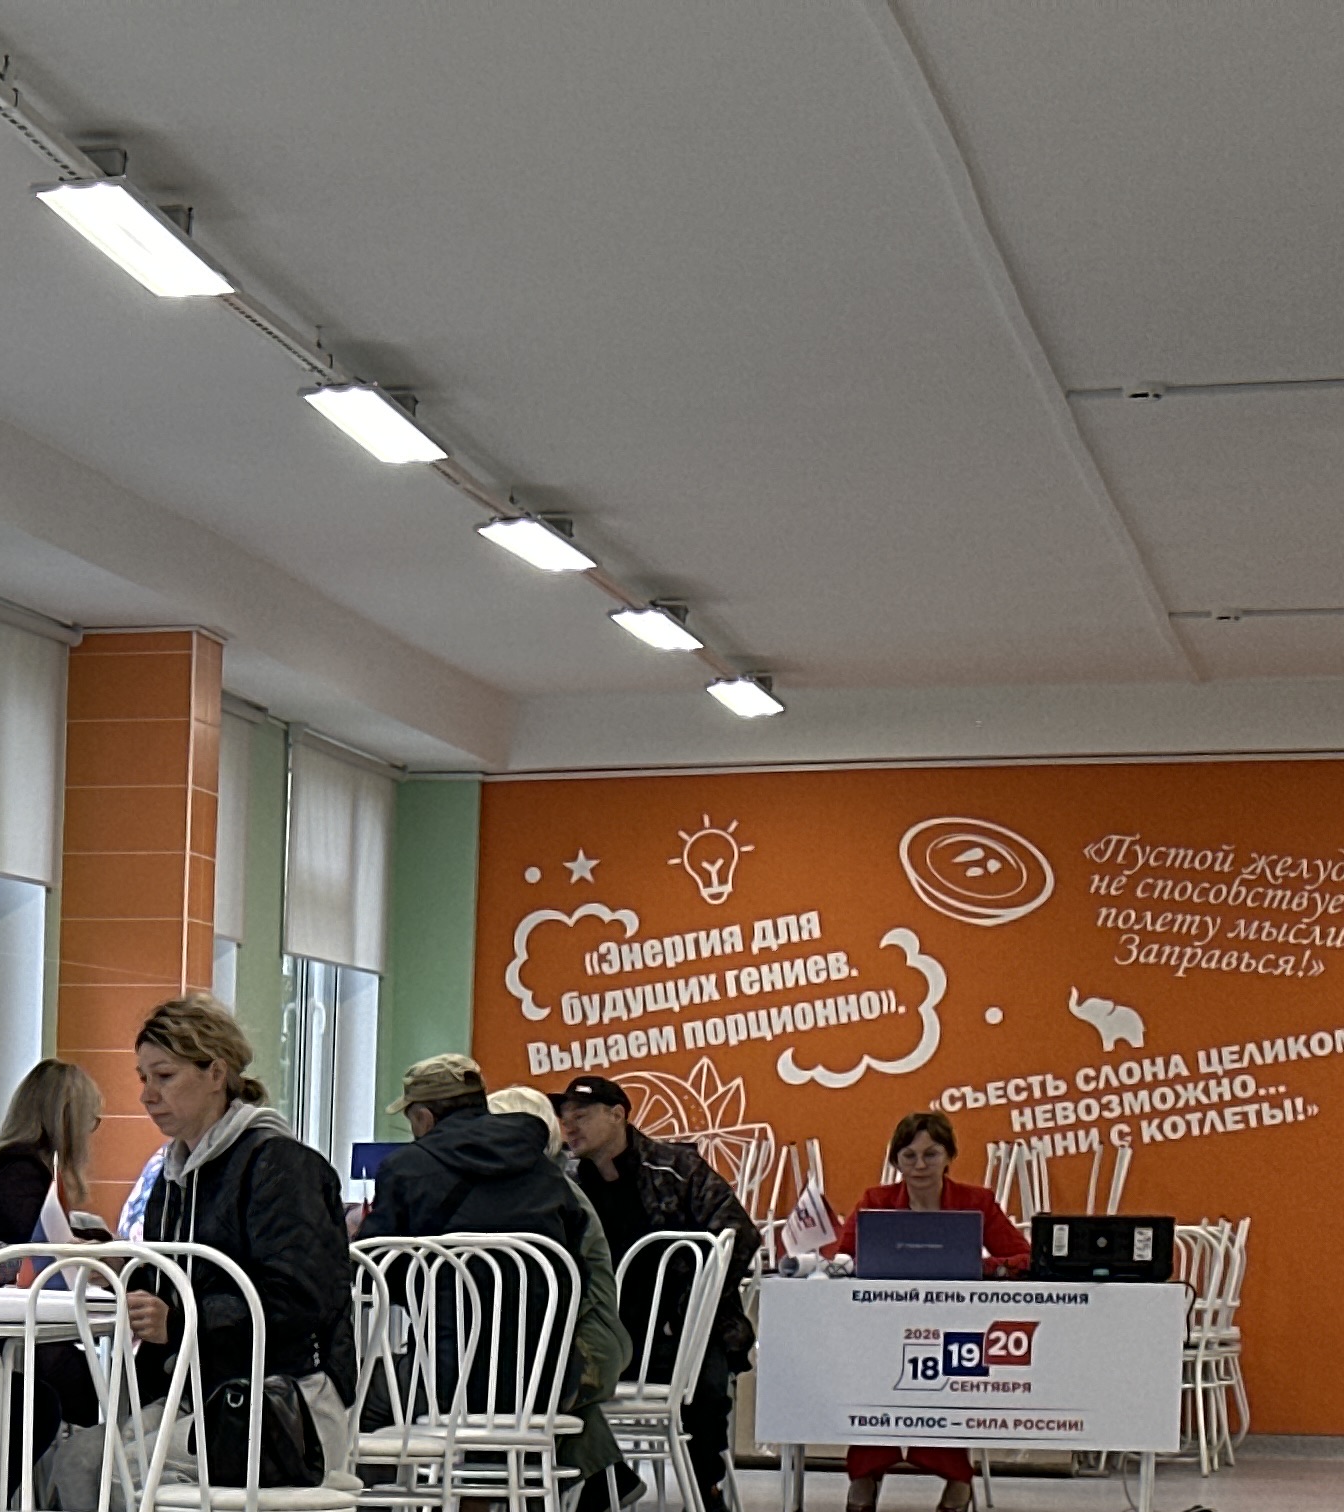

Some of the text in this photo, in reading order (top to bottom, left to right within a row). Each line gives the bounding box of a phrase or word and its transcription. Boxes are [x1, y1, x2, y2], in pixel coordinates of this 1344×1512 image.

[1083, 832, 1234, 874] «Пустой
[1089, 872, 1127, 897] не
[584, 911, 821, 976] «Энергия для
[1096, 905, 1221, 946] полету
[1114, 934, 1325, 978] Заправься!»
[561, 951, 859, 1027] будущих гениев.
[527, 989, 906, 1077] Выдаем порционно».
[929, 1072, 1068, 1114] «СЪЕСТЬ
[1075, 1053, 1190, 1092] СЛОНА
[1010, 1073, 1287, 1133] НЕВОЗМОЖНО...
[1109, 1123, 1132, 1148] С
[1141, 1096, 1320, 1145] КОТЛЕТЫ!»
[851, 1287, 1089, 1306] ЕДИНЫЙ ДЕНЬ ГОЛОСОВАНИЯ
[904, 1328, 941, 1341] 2026
[907, 1330, 1029, 1382] 18 19 20
[949, 1380, 1032, 1394] СЕНТЯБРЯ
[849, 1413, 891, 1428] ТВОЙ
[895, 1416, 948, 1430] ГОЛОС
[966, 1417, 1010, 1432] СИЛА
[1014, 1418, 1085, 1432] РОССИИ!
